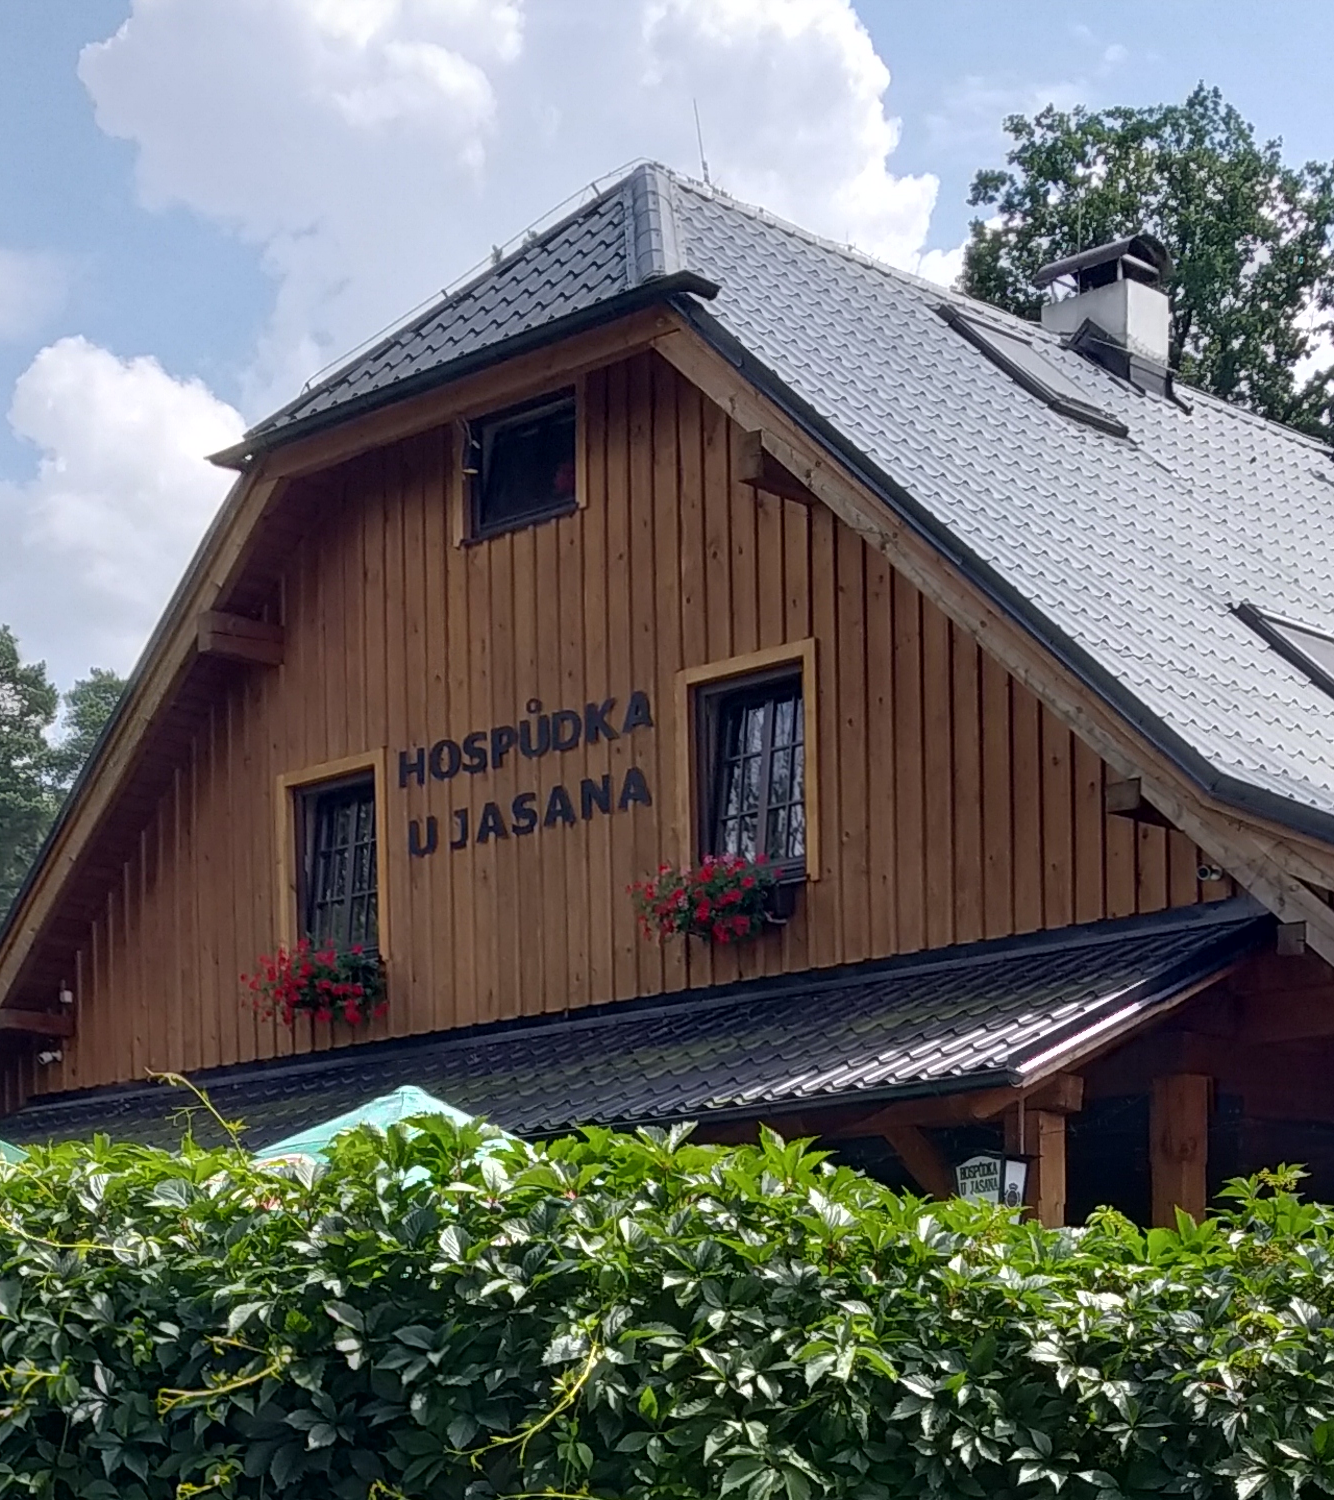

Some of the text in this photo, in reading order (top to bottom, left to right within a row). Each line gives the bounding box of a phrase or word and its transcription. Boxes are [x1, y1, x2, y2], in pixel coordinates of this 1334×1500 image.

[398, 690, 654, 789] HOSPŮDKA
[408, 766, 653, 858] U JASANA
